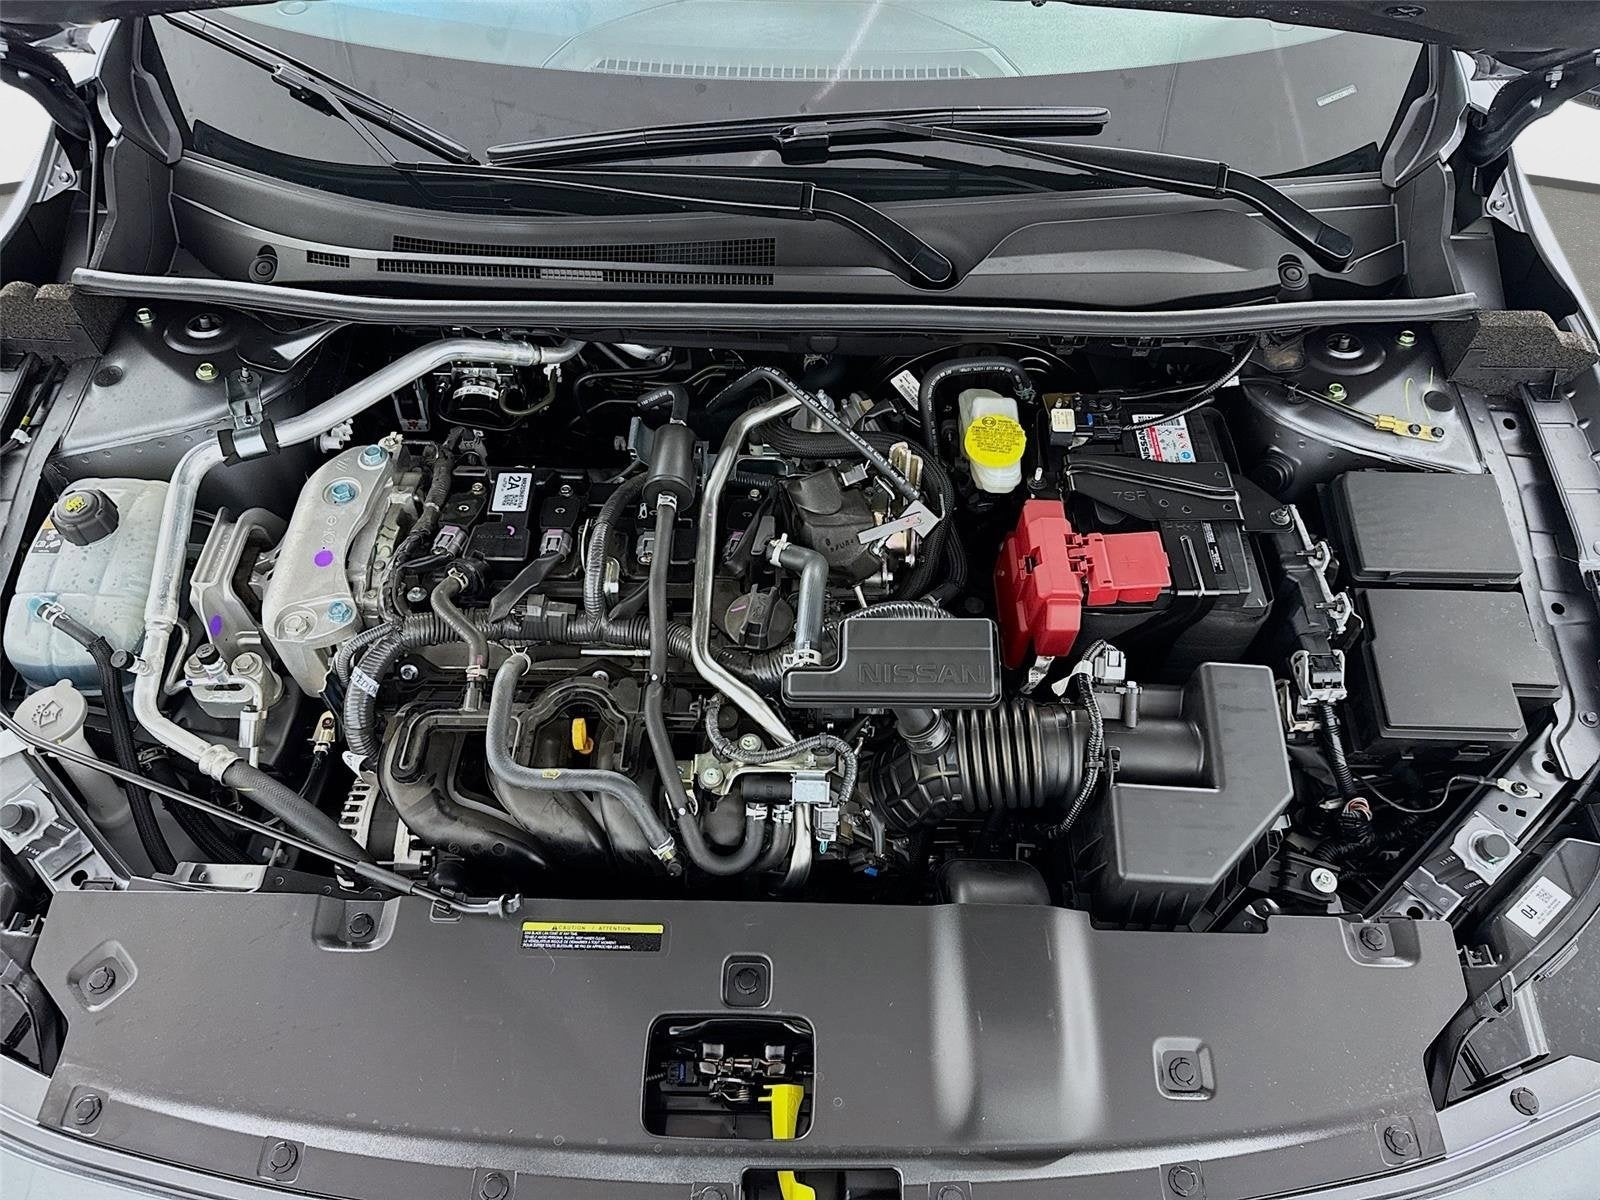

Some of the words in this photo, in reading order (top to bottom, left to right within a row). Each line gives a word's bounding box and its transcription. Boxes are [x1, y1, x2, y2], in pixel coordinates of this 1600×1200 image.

[1138, 429, 1152, 461] NISSAN
[507, 475, 521, 491] 2A
[858, 664, 985, 683] NISSAN
